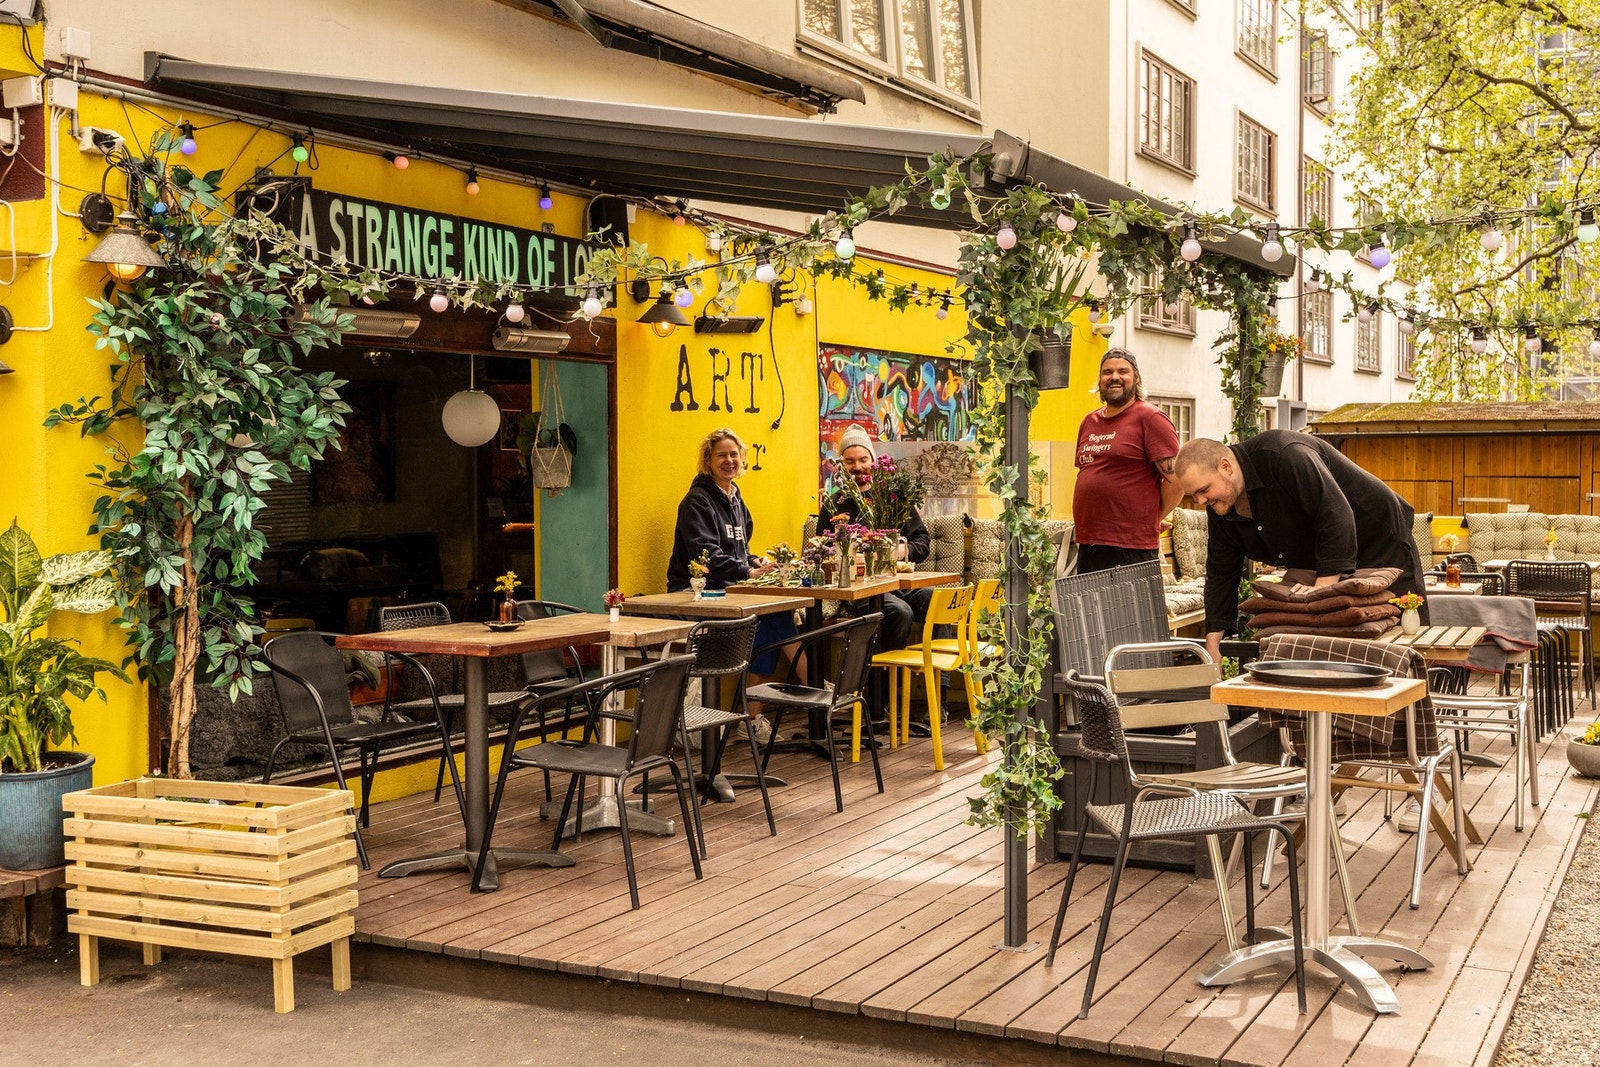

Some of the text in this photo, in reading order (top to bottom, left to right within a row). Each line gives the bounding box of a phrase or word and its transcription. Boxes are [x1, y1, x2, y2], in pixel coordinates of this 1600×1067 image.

[298, 193, 614, 302] A STRANGE KIND OF LO
[670, 343, 763, 413] ART
[1079, 454, 1094, 464] Club
[1081, 444, 1111, 453] Swingers
